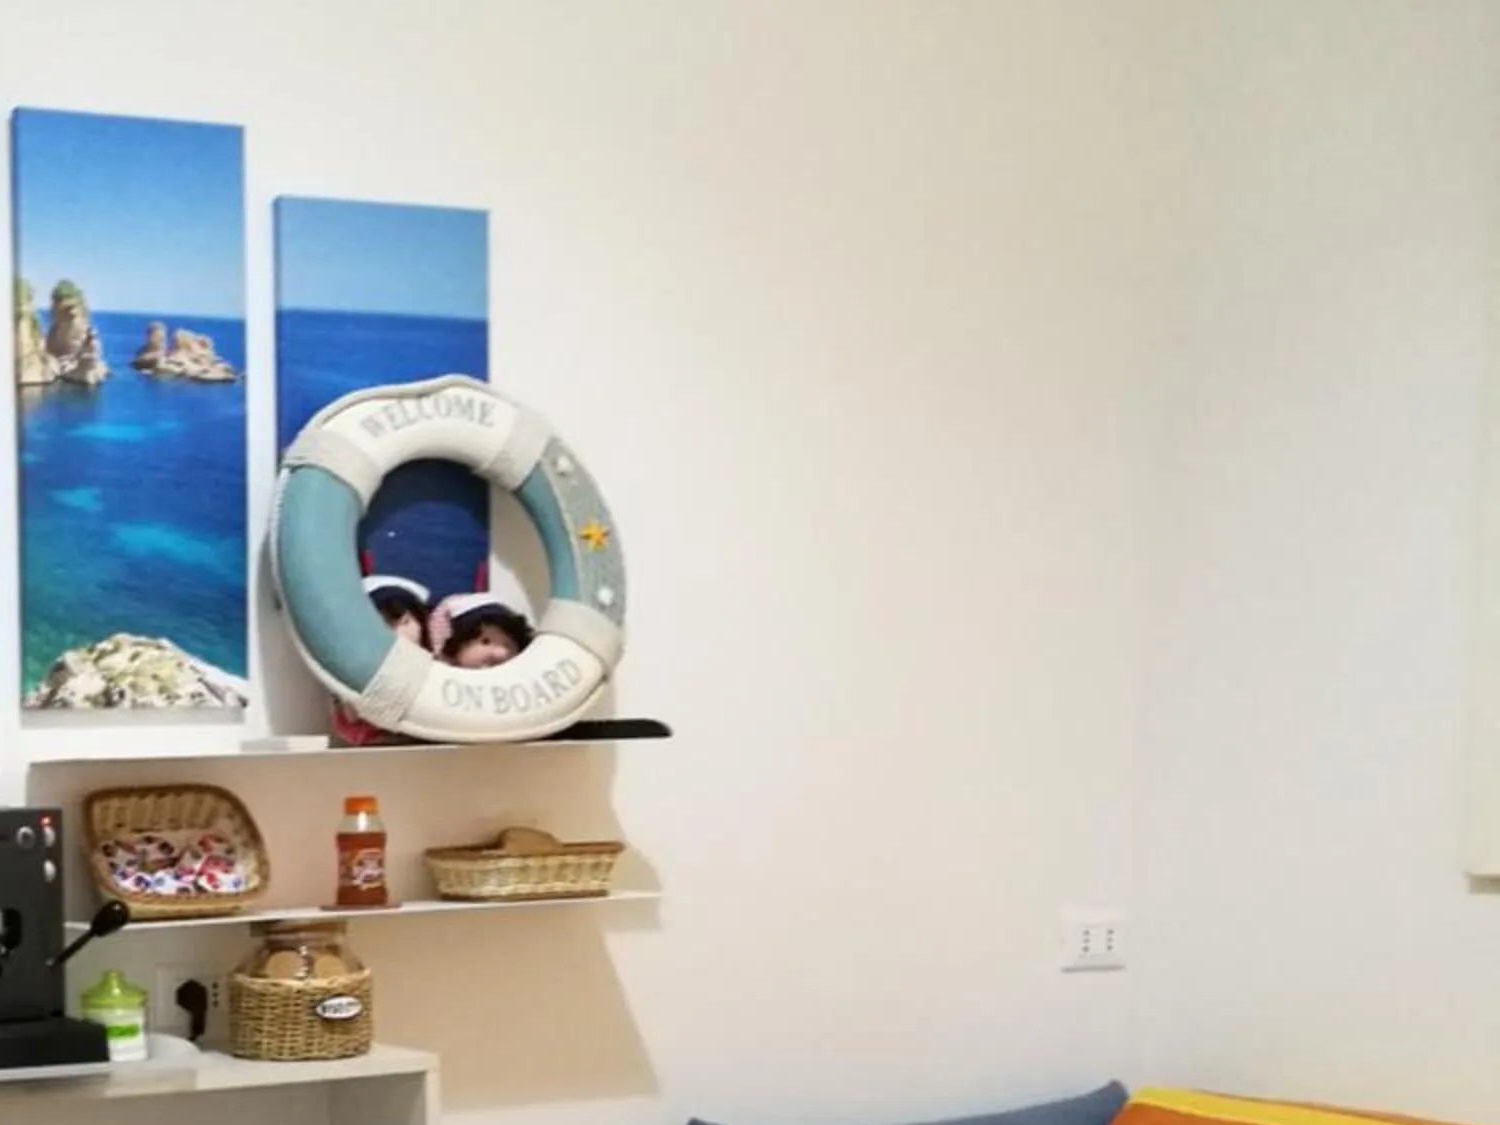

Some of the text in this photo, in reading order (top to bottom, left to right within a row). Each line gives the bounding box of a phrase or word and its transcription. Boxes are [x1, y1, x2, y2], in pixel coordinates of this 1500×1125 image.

[361, 394, 495, 437] WELCOME
[442, 658, 581, 714] ON BOARD
